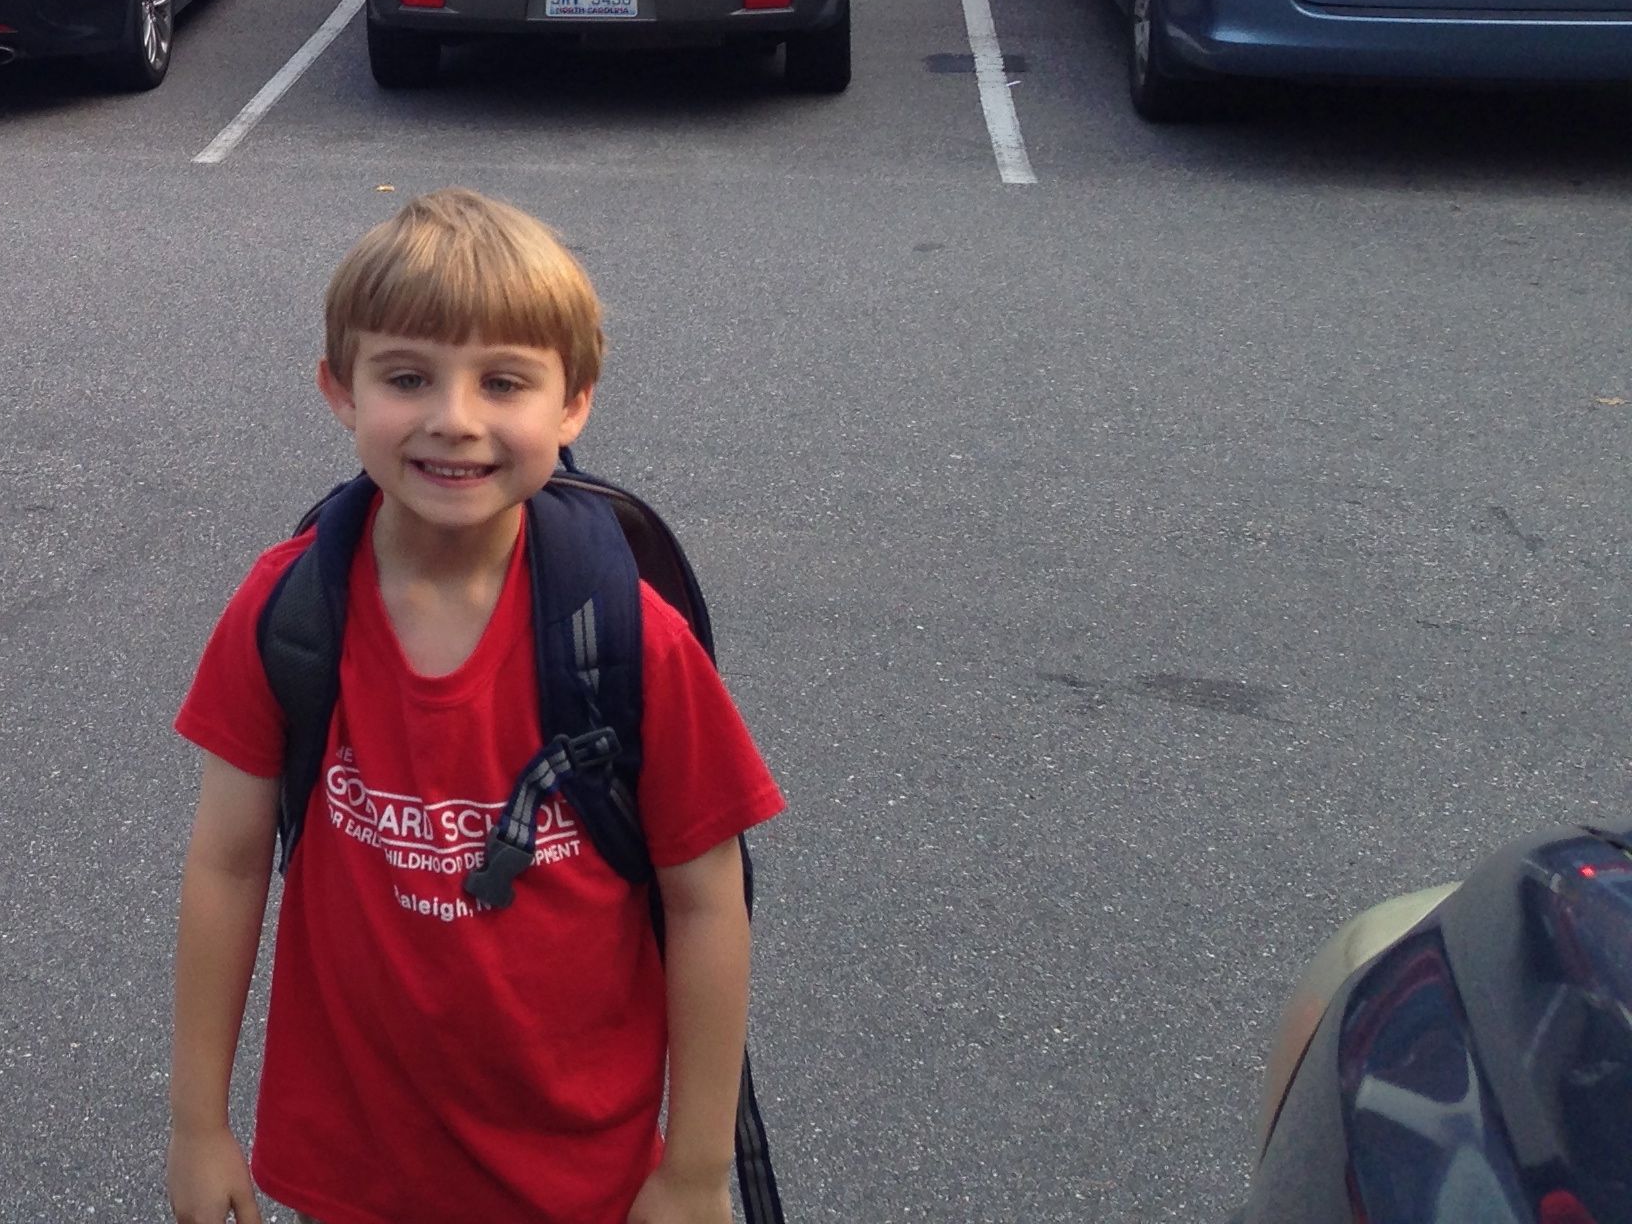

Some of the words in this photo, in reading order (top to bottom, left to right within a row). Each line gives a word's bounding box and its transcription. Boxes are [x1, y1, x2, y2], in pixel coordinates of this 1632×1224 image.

[327, 764, 434, 841] GOARD
[441, 800, 575, 842] SCOL
[344, 818, 382, 849] EARL
[383, 846, 463, 875] HILDHOOD
[464, 839, 581, 870] DEPMENT
